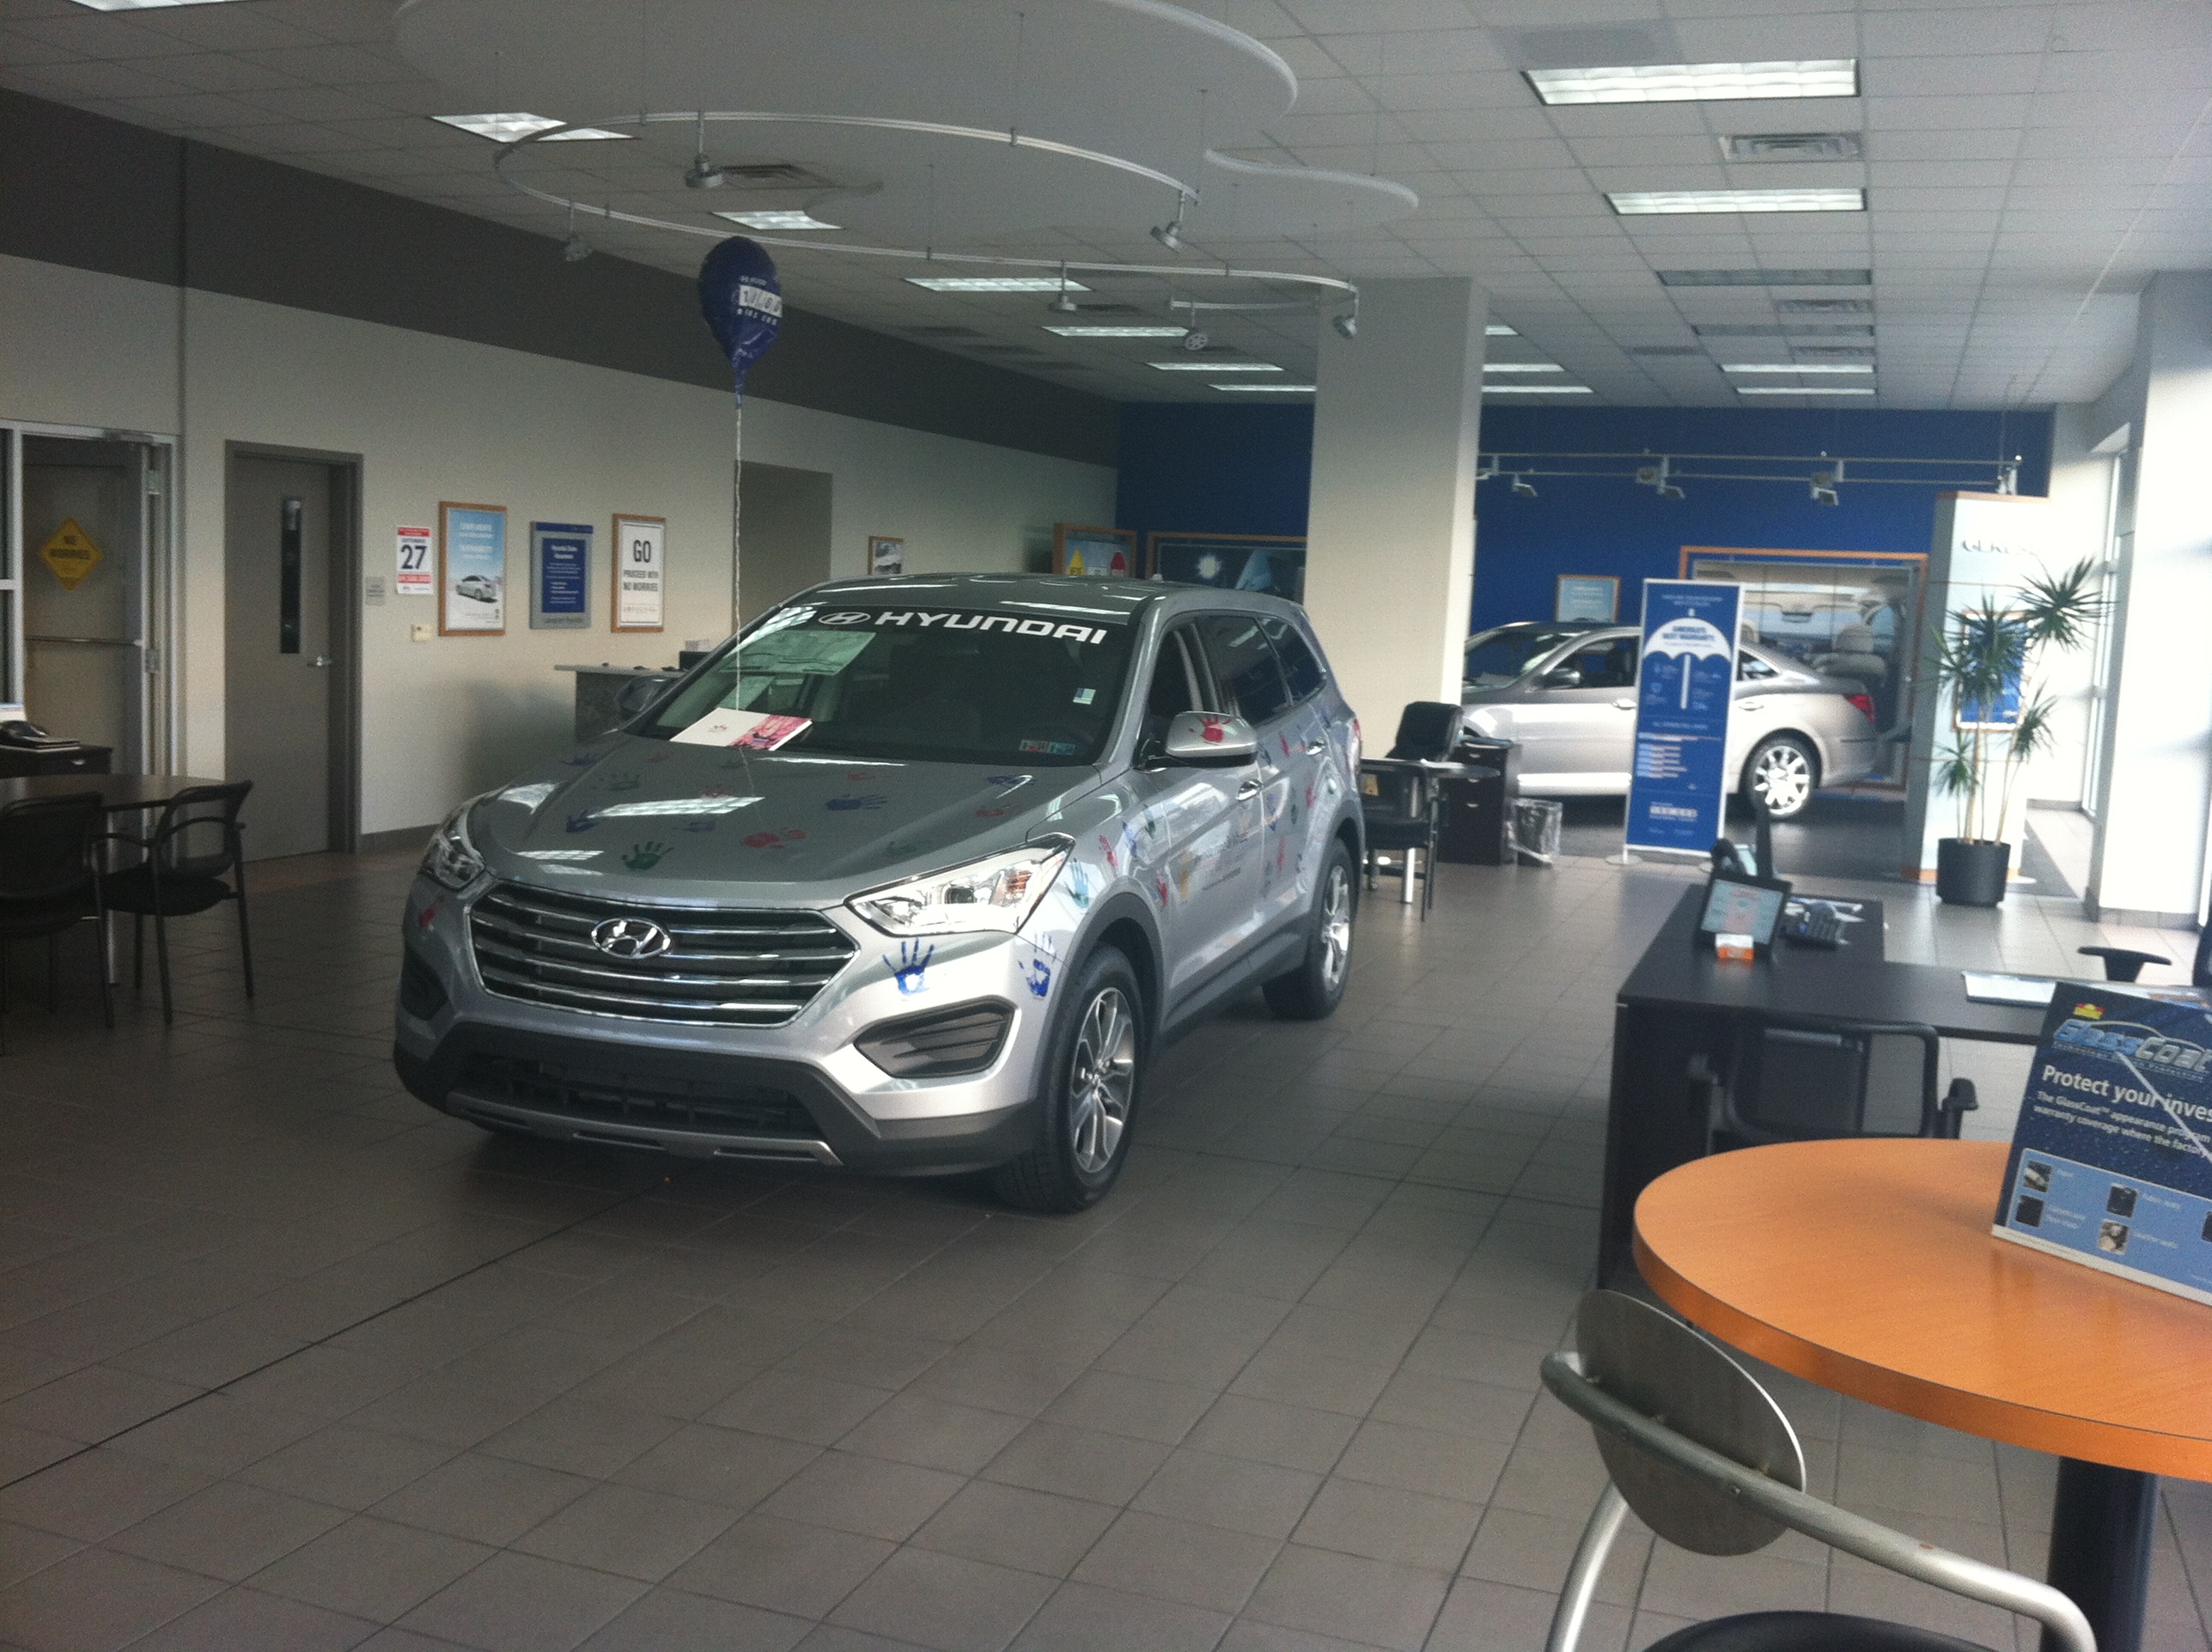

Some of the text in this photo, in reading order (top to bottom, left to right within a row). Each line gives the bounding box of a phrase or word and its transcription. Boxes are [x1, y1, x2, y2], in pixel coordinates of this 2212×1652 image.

[400, 544, 428, 569] 27
[633, 539, 652, 563] GO
[623, 582, 659, 592] NO WORRIES
[874, 611, 1108, 644] HYUNDAI
[2042, 1065, 2110, 1096] Protect
[2112, 1085, 2160, 1108] your
[2034, 1106, 2077, 1124] warranty
[2077, 1115, 2121, 1134] coverage
[2121, 1127, 2152, 1142] where
[2154, 1135, 2172, 1148] the
[2037, 1091, 2054, 1103] The
[2110, 1112, 2167, 1132] appearance
